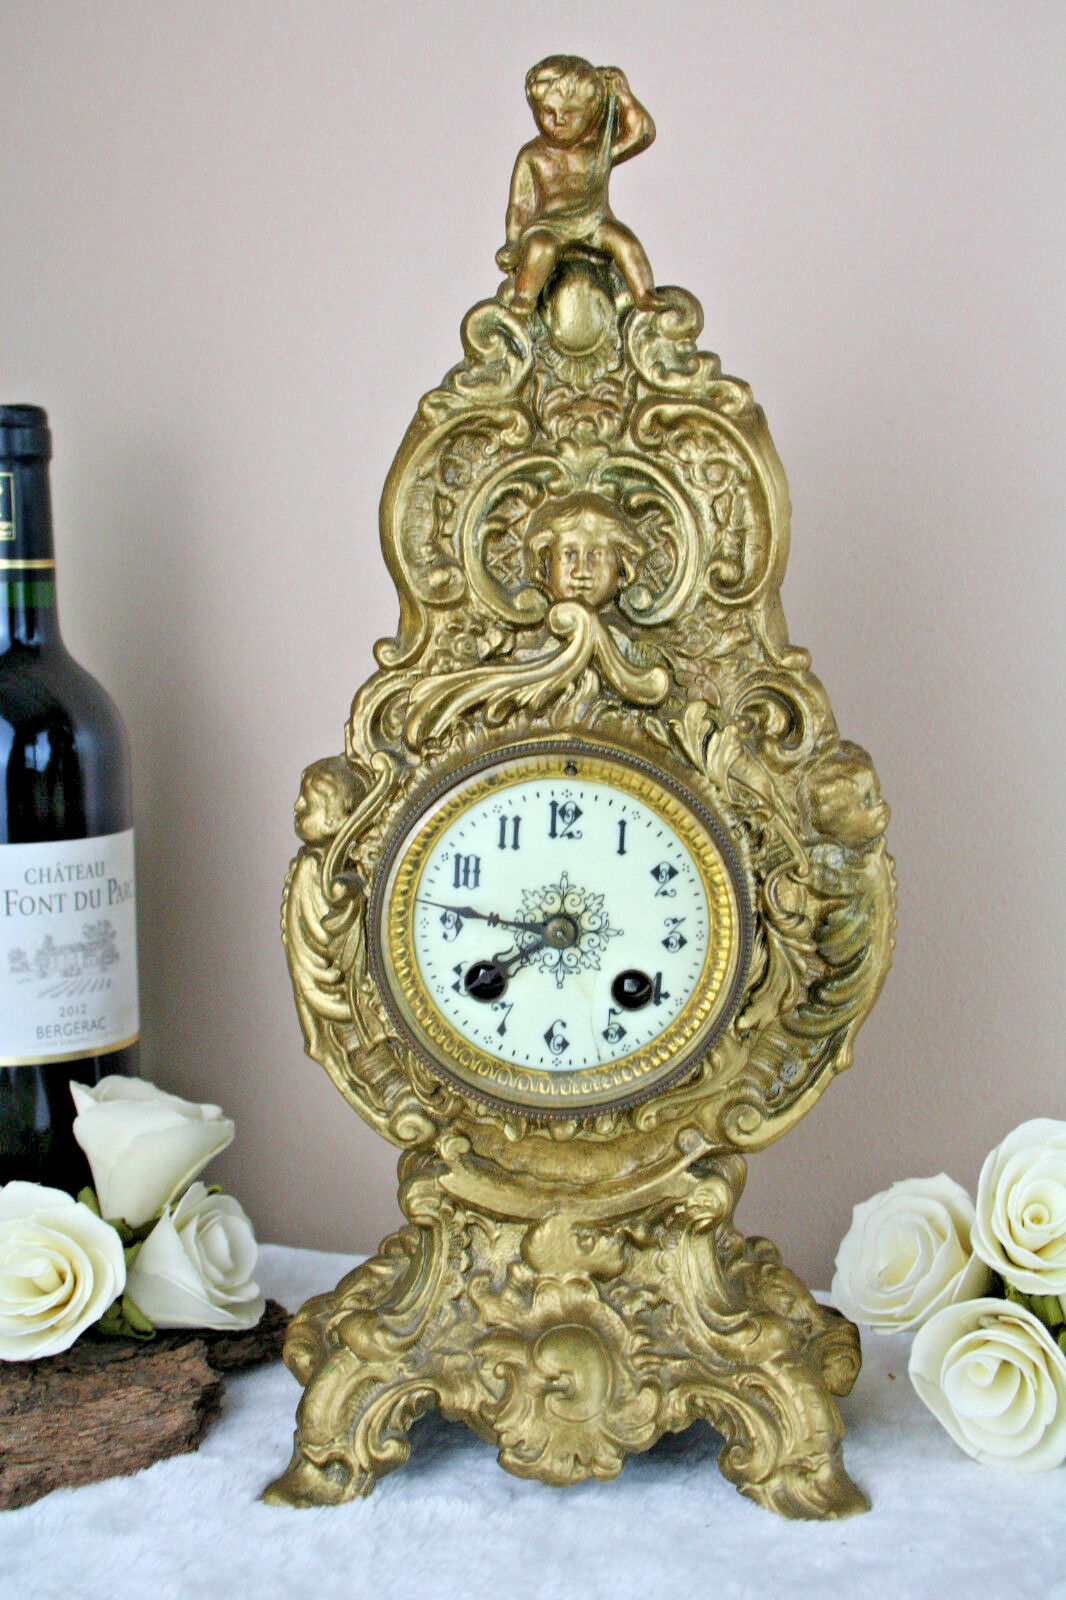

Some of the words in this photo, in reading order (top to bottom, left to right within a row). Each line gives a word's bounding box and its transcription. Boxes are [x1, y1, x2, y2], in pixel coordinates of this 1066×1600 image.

[497, 814, 522, 851] 11
[548, 800, 583, 840] 12
[616, 818, 627, 856] 1
[24, 861, 105, 886] CHÂTEAU
[452, 852, 481, 890] 10
[650, 860, 679, 898] 2
[4, 888, 68, 917] FONT
[74, 889, 101, 912] DU
[439, 908, 464, 943] 9
[661, 916, 688, 954] 3
[36, 1015, 106, 1040] BERGERAC
[59, 1003, 88, 1018] 2012
[491, 1000, 514, 1037] 7
[602, 1007, 627, 1045] 5
[543, 1018, 570, 1056] 6
